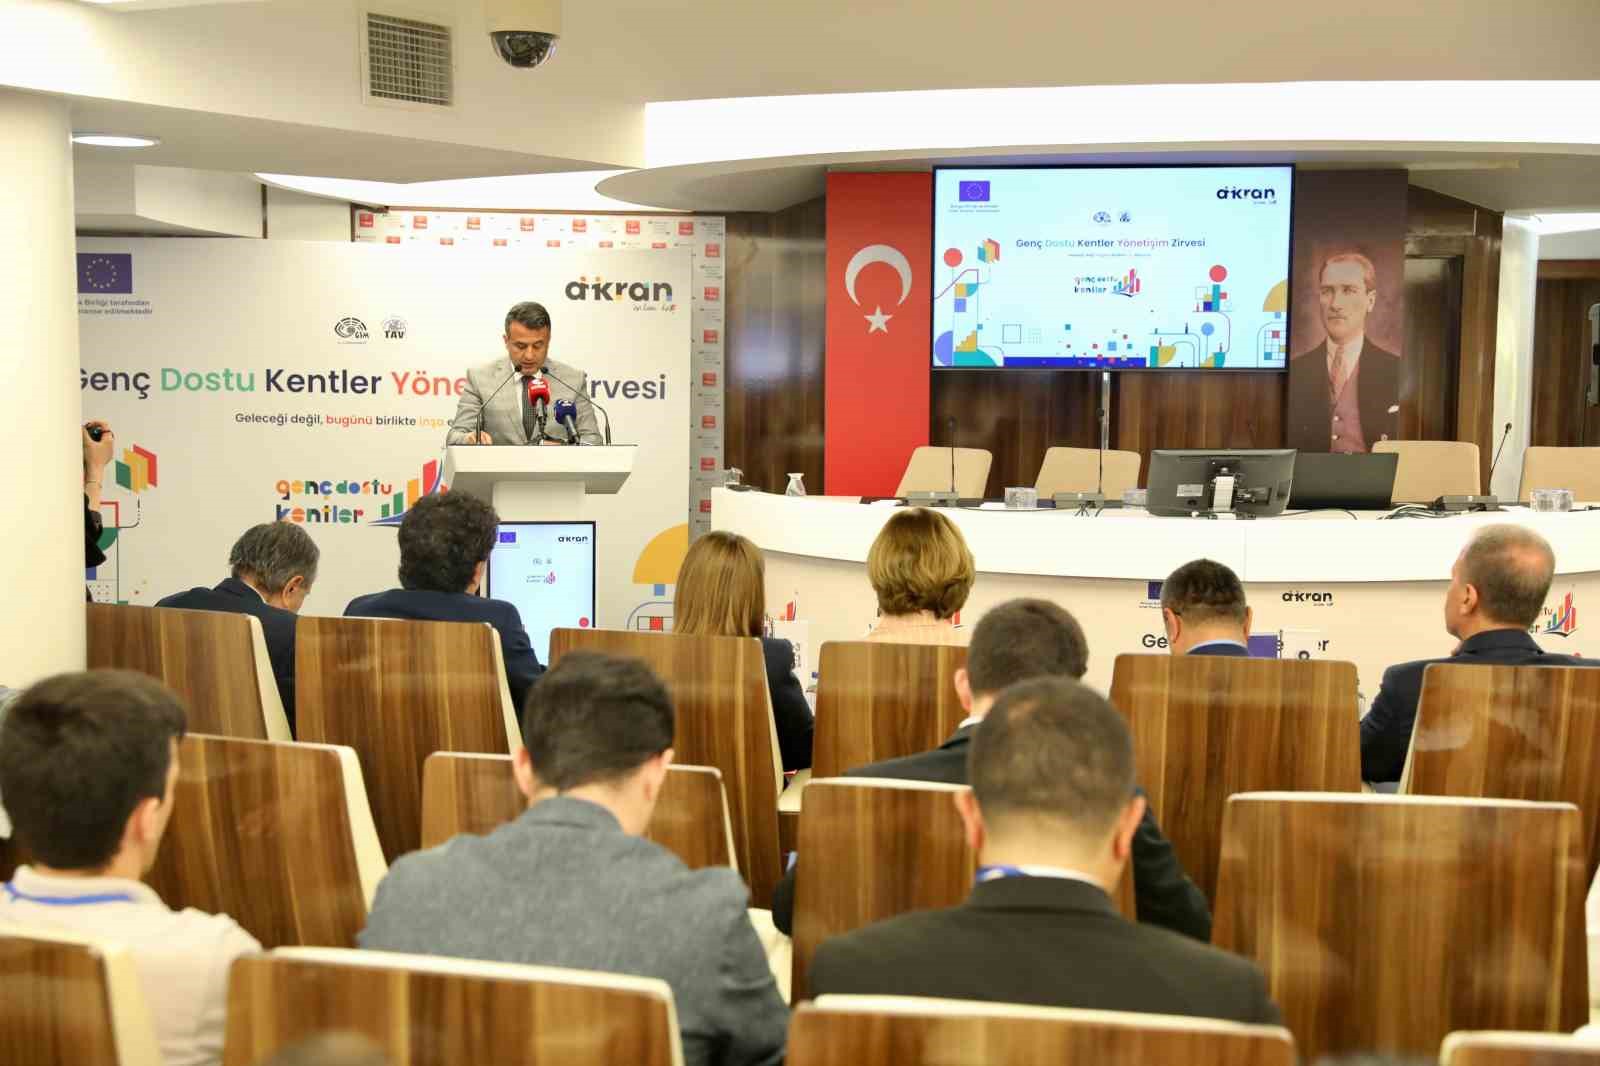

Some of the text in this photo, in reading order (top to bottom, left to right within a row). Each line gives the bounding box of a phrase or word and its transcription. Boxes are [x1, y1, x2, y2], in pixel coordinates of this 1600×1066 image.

[1016, 238, 1206, 250] Genç Dostu Kentler Yönetişim Zirvesi
[160, 368, 256, 392] Dostu
[265, 368, 383, 395] Kentler
[235, 412, 288, 427] Geleceği
[290, 413, 323, 427] değil,
[326, 415, 373, 428] bugünü
[375, 415, 416, 427] birlikte
[276, 479, 392, 500] genç dostu
[276, 504, 364, 523] kentler
[1142, 633, 1168, 648] Ge
